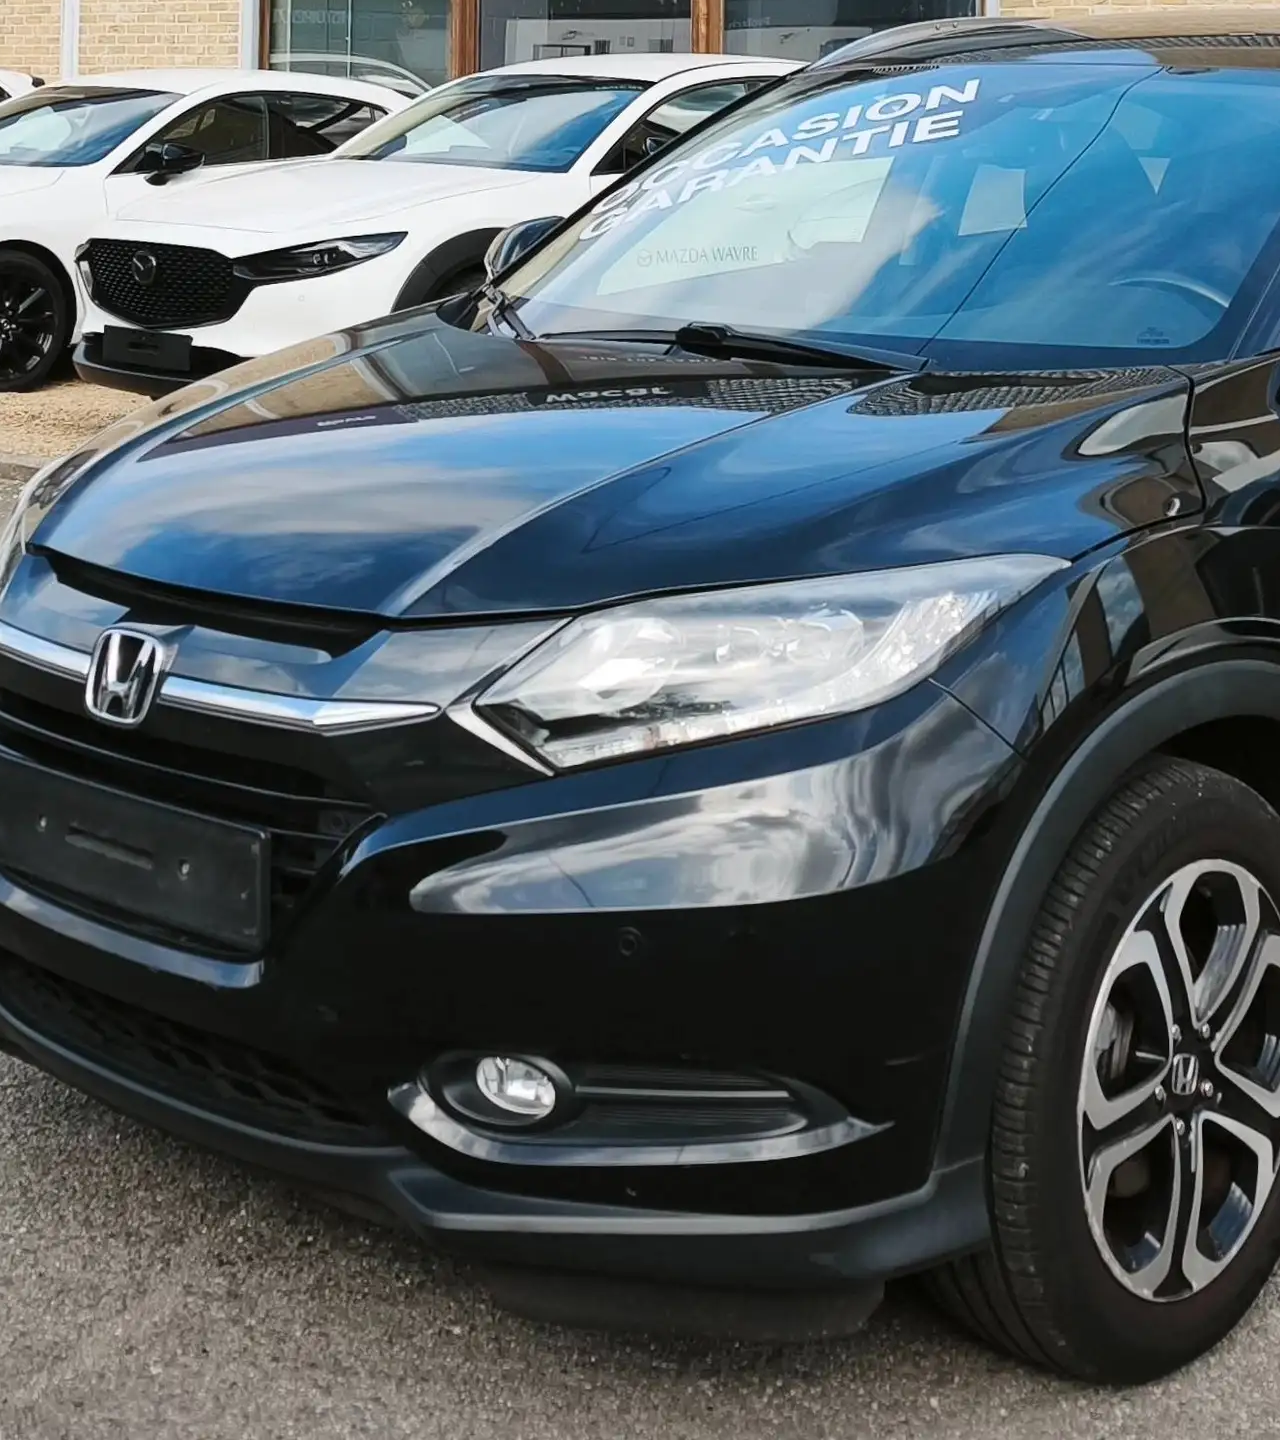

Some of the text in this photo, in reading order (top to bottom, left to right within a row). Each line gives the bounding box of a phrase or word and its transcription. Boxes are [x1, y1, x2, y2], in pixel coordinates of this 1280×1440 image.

[578, 110, 964, 242] GARANTIE
[591, 77, 981, 216] OCCASION
[656, 246, 759, 265] MAZDA WAVRE
